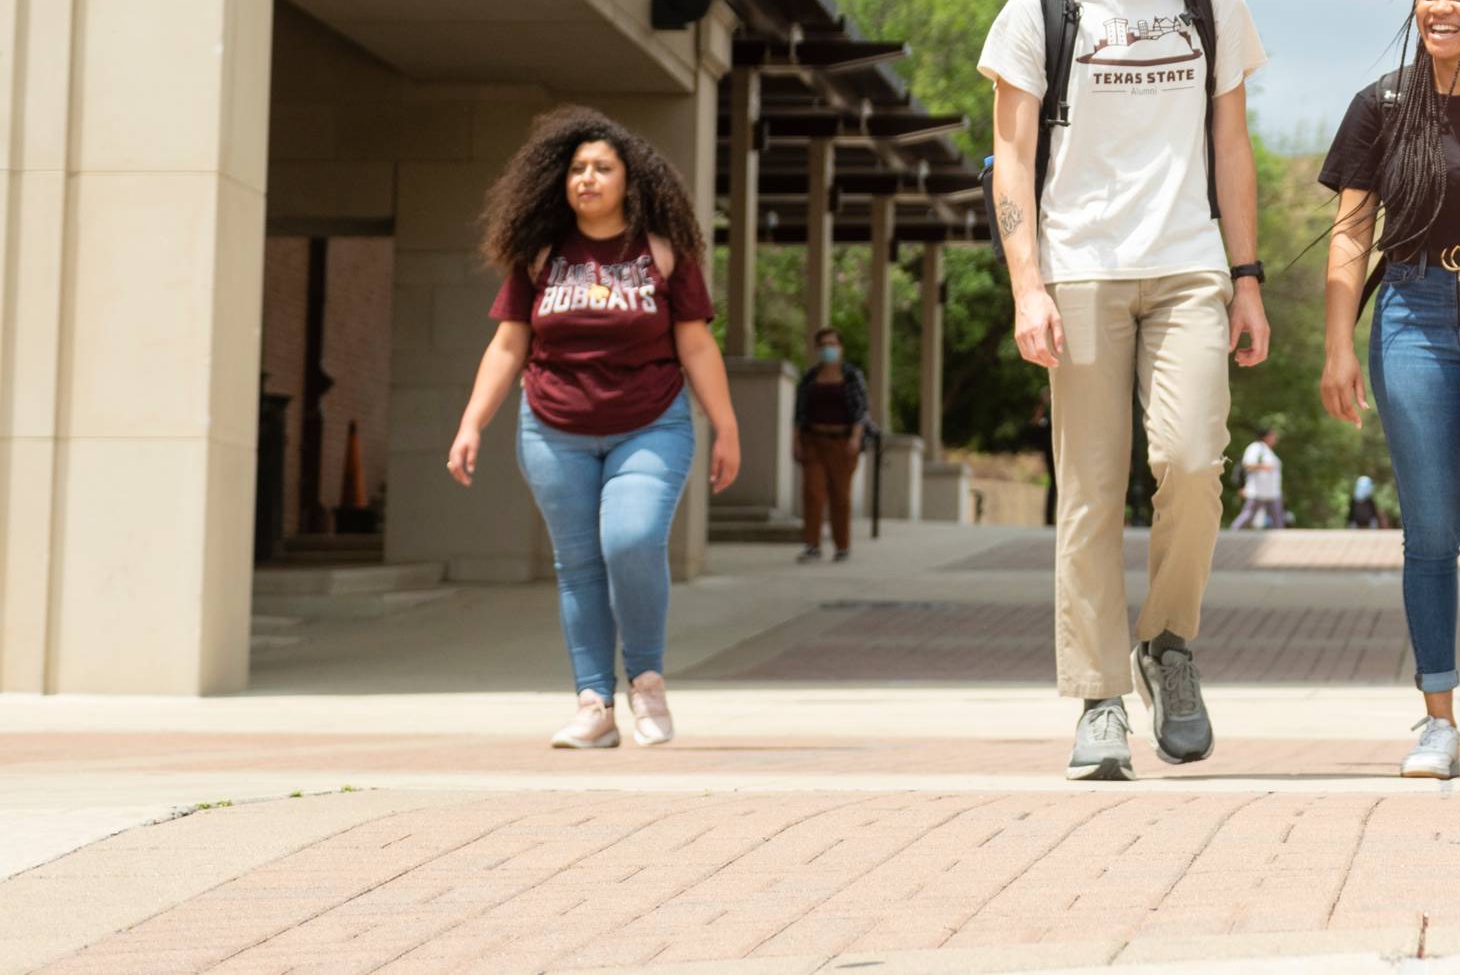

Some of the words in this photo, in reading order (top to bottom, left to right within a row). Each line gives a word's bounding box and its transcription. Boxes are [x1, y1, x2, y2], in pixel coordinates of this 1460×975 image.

[1093, 72, 1142, 84] TEXAS
[1147, 69, 1195, 84] STATE
[1130, 87, 1158, 96] Alumni
